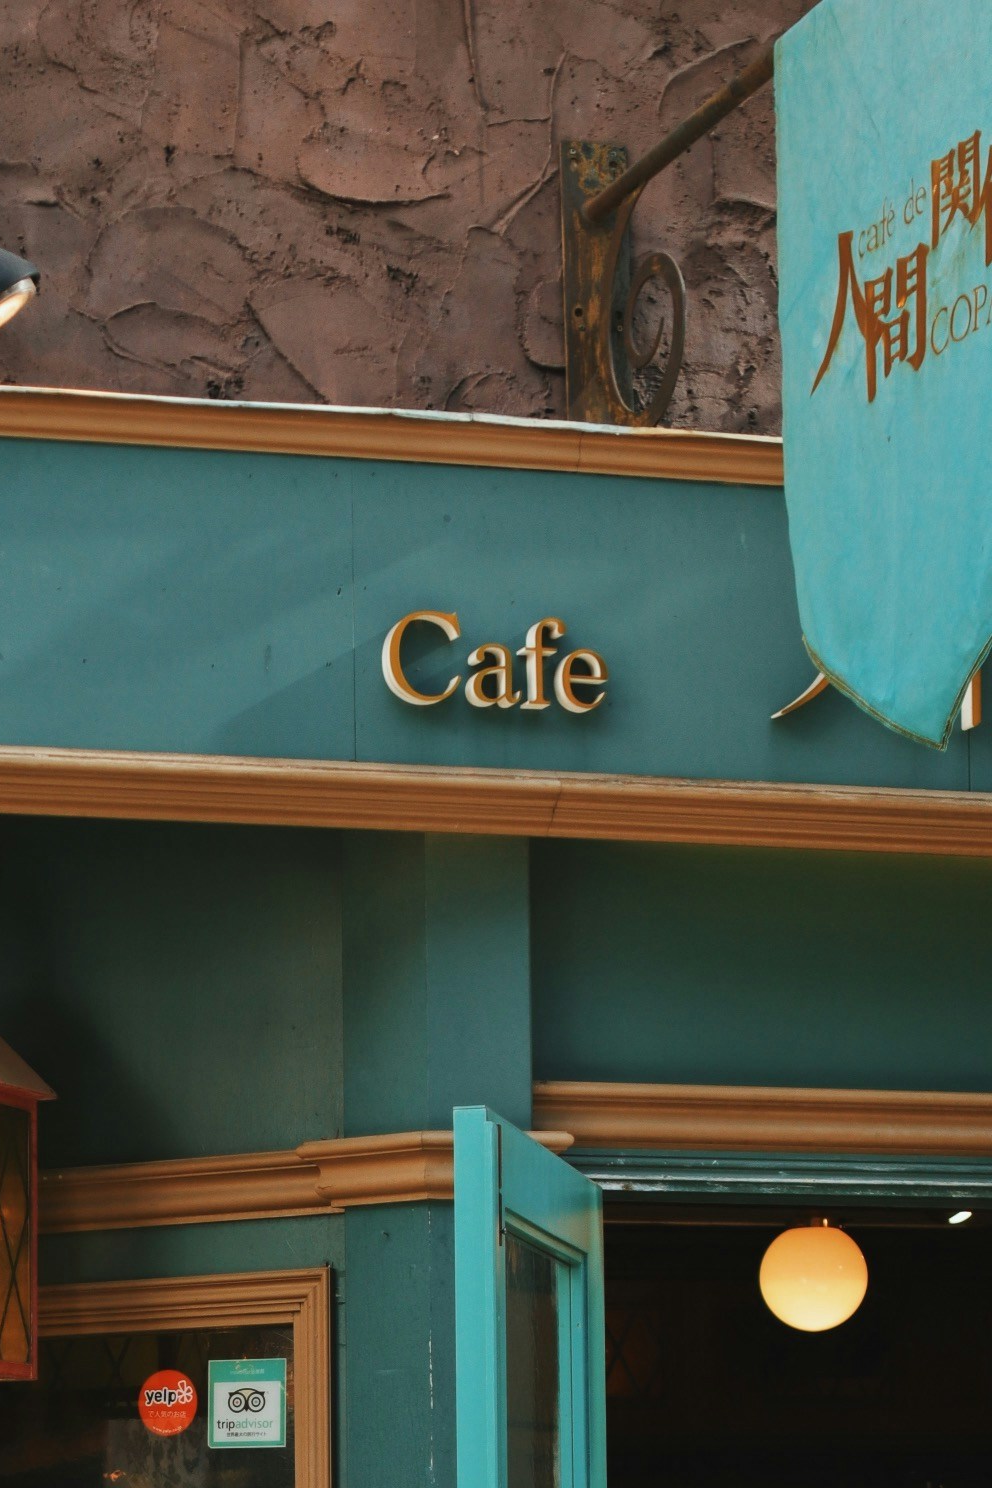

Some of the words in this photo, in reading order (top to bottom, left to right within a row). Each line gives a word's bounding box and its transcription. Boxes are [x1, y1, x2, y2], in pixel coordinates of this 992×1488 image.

[858, 196, 895, 258] café
[904, 178, 927, 225] de
[810, 230, 930, 403] 人間
[930, 284, 992, 356] COP
[381, 610, 609, 715] Cafe
[145, 1387, 178, 1406] yelp
[148, 1410, 187, 1419] で人気のお店
[216, 1418, 274, 1431] tripadvisor
